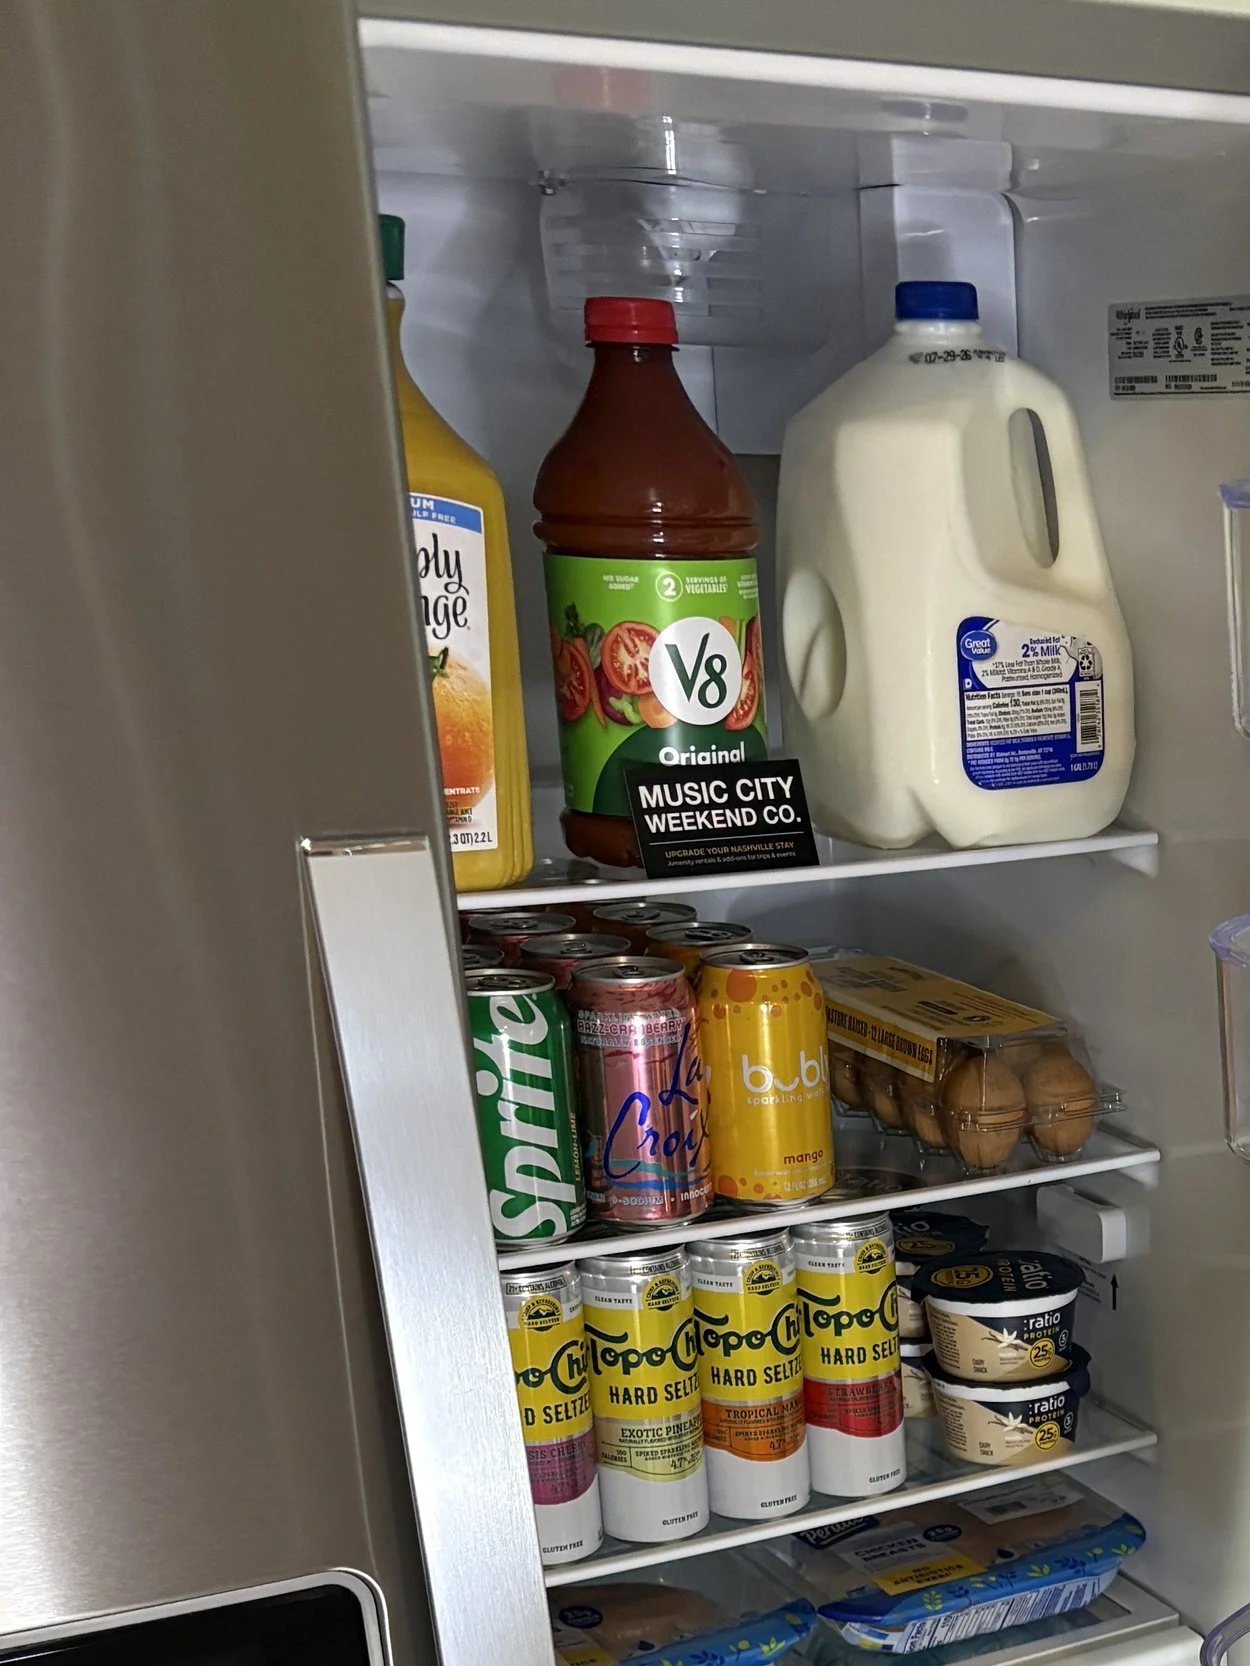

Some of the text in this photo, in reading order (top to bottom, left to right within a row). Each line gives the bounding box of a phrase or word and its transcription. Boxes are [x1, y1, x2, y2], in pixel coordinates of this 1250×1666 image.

[417, 532, 470, 595] ply
[662, 577, 676, 596] 2
[964, 638, 991, 649] Great
[971, 647, 991, 655] Value
[1021, 644, 1061, 658] 2% Milk
[664, 633, 727, 709] V8
[638, 776, 794, 809] MUSIC CITY
[643, 804, 802, 834] WEEKEND CO.
[665, 841, 795, 858] UPGRADE YOUR NASHVILLE STAY
[848, 1015, 933, 1065] RAISED LARGE BROWN EGGS
[659, 1021, 704, 1106] La
[748, 1093, 803, 1105] sparkling
[473, 996, 577, 1239] Sprite
[603, 1092, 710, 1179] Croix
[568, 1112, 580, 1182] LEMON-LIME
[784, 1149, 824, 1164] mango
[808, 1260, 826, 1268] CLEAN
[698, 1278, 733, 1288] CLEAN TASTE
[595, 1295, 612, 1303] CLEAN
[797, 1288, 877, 1337] Topo
[693, 1307, 766, 1357] Topo
[1023, 1325, 1060, 1340] PROTEIN
[584, 1324, 667, 1375] Topo
[821, 1336, 900, 1365] HARD SELT
[710, 1360, 801, 1387] HARD SELTZ
[609, 1385, 658, 1405] HARD
[543, 1394, 591, 1426] SELTZE
[725, 1408, 780, 1420] TROPICAL
[1028, 1408, 1065, 1424] PROTEIN
[621, 1427, 663, 1438] EXOTIC
[760, 1494, 798, 1508] GLUTEN FREE
[662, 1511, 699, 1526] GLUTEN FREE
[542, 1540, 584, 1554] GLUTEN FREE
[854, 1538, 918, 1558] CHICKEN
[862, 1542, 927, 1562] BREASTS
[893, 1563, 964, 1586] ANTIBIOTICS
